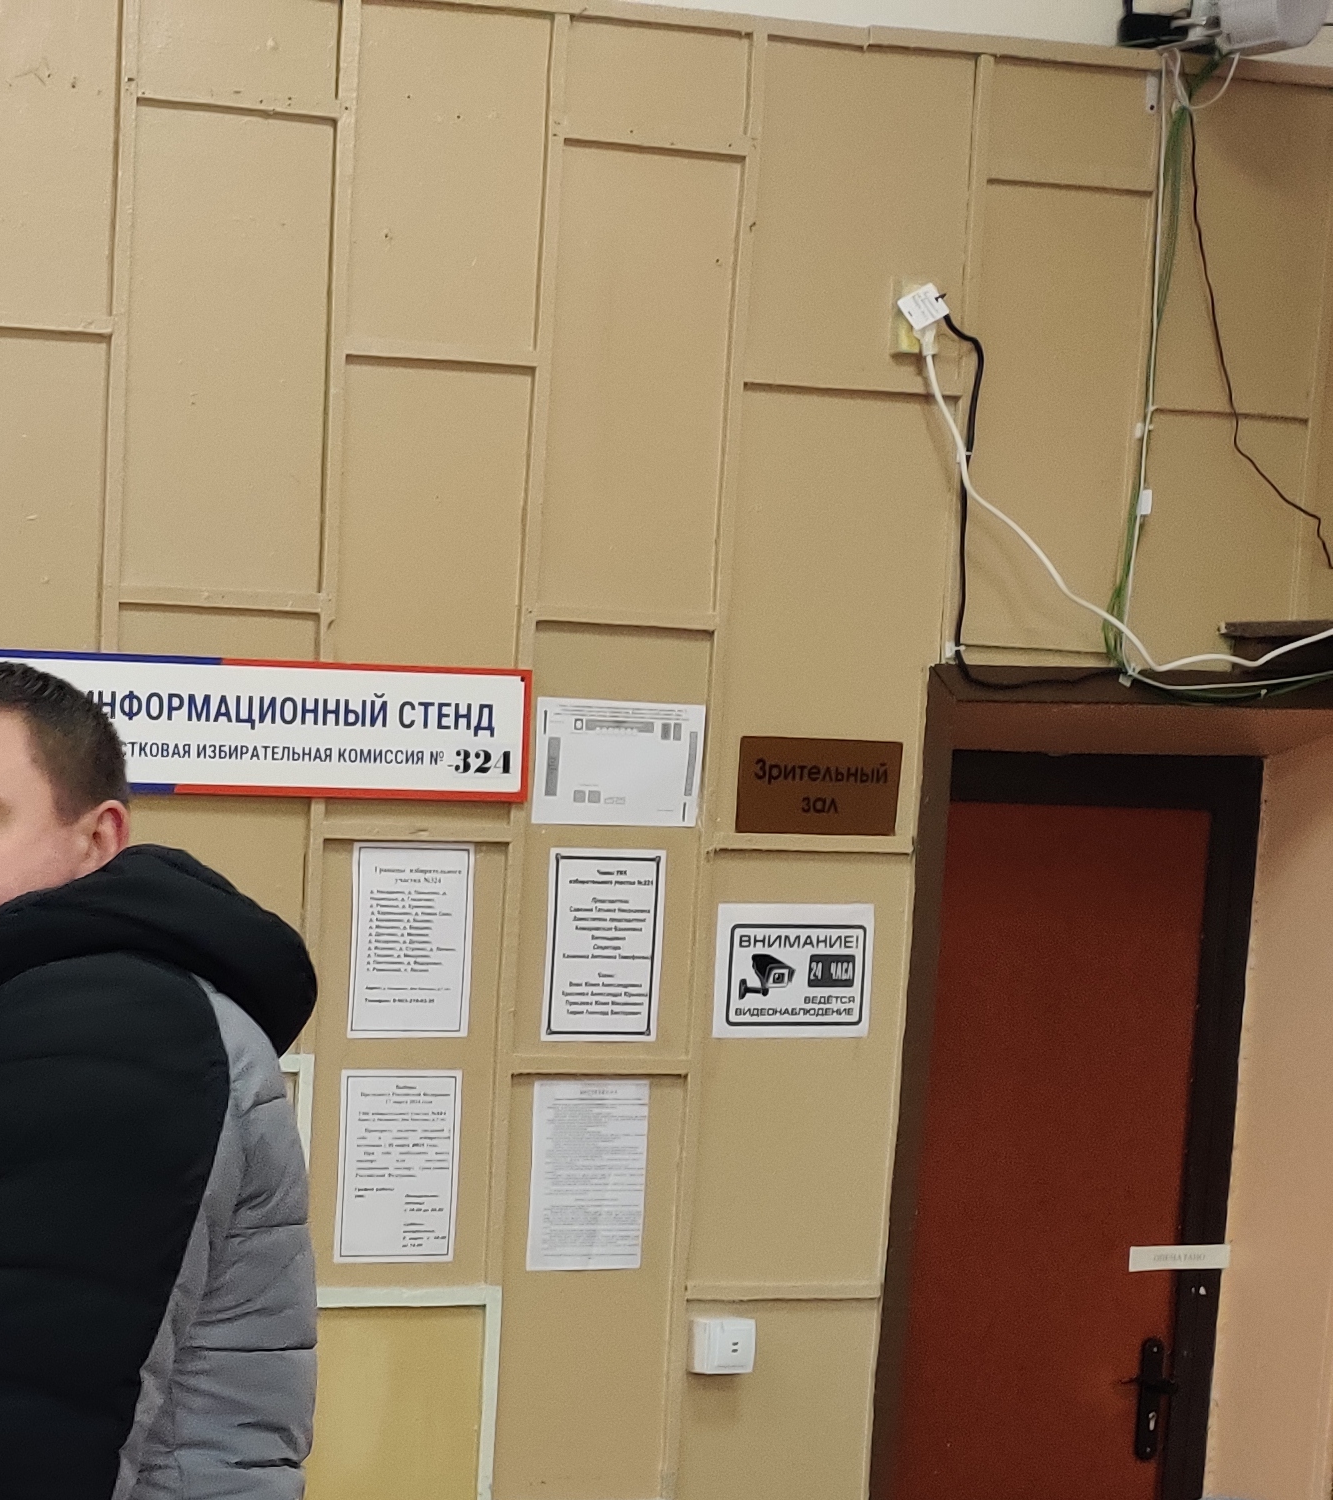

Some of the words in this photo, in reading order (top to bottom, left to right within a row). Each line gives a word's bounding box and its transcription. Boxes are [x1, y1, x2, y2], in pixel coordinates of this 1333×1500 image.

[398, 700, 496, 738] СТЕНД
[120, 741, 192, 759] ТКОВАЯ
[196, 743, 333, 763] ИЗБИРАТЕЛЬНАЯ
[337, 748, 425, 765] КОМИССИЯ
[453, 748, 512, 775] 324
[753, 757, 889, 786] Зрительный
[801, 796, 839, 814] зал
[738, 934, 860, 949] ВНИМАНИЕ!
[810, 962, 823, 980] 24
[830, 961, 854, 981] ЧАСА
[803, 995, 856, 1005] ВЕДЁТСЯ
[734, 1007, 854, 1018] ВИДЕОНАБЛЮДЕНИЕ
